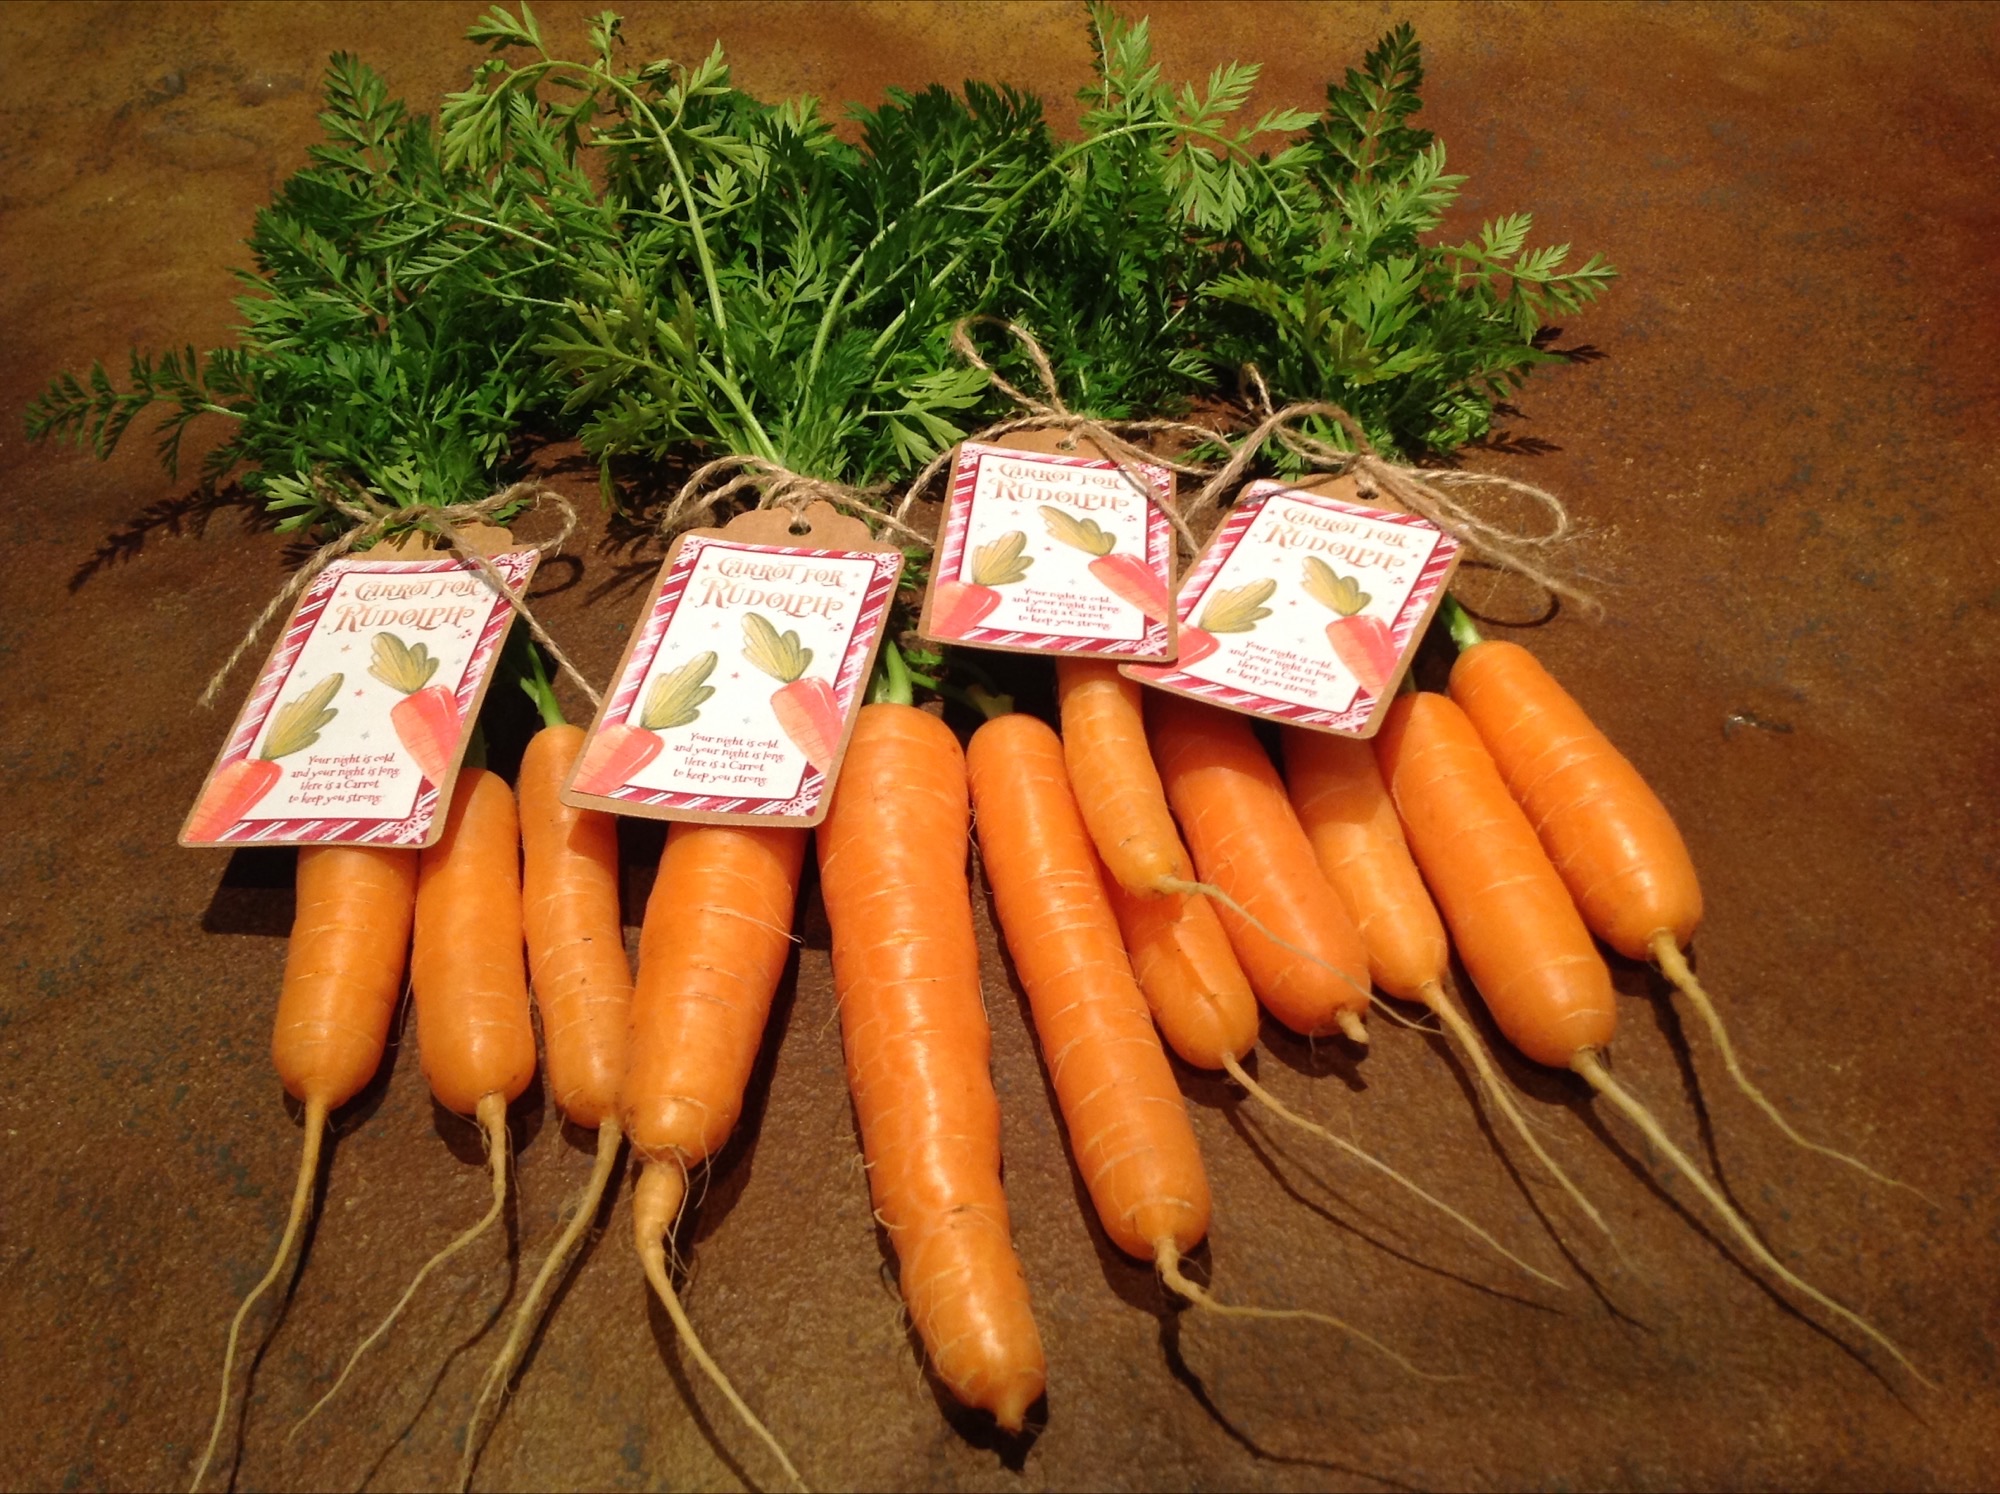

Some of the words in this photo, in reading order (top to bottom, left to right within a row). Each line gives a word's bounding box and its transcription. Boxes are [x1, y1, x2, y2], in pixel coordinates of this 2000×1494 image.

[999, 463, 1083, 482] CARROT
[1078, 474, 1126, 490] FOR
[988, 478, 1130, 513] RUDOLPH
[1282, 506, 1368, 534] CARROT
[1358, 524, 1410, 548] FOR
[1258, 520, 1406, 574] RUDOLPH
[718, 556, 807, 582] CARROT
[796, 568, 846, 588] FOR
[355, 580, 442, 601] CARROT
[431, 580, 483, 599] FOR
[694, 577, 844, 620] RUDOLPH
[327, 602, 475, 635] RUDOLPH
[690, 732, 715, 743] Your
[716, 736, 744, 748] night
[308, 754, 332, 766] Your
[332, 754, 361, 768] night
[672, 743, 694, 753] and
[692, 746, 720, 756] your
[720, 748, 750, 760] night
[290, 768, 311, 778] and
[308, 769, 336, 780] your
[337, 766, 366, 780] night
[684, 756, 708, 768] Here
[728, 760, 765, 772] Carrot
[300, 781, 322, 790] Here
[344, 780, 380, 790] Carrot
[686, 768, 710, 783] keep
[708, 774, 731, 784] you
[300, 792, 324, 806] keep
[322, 794, 346, 806] you
